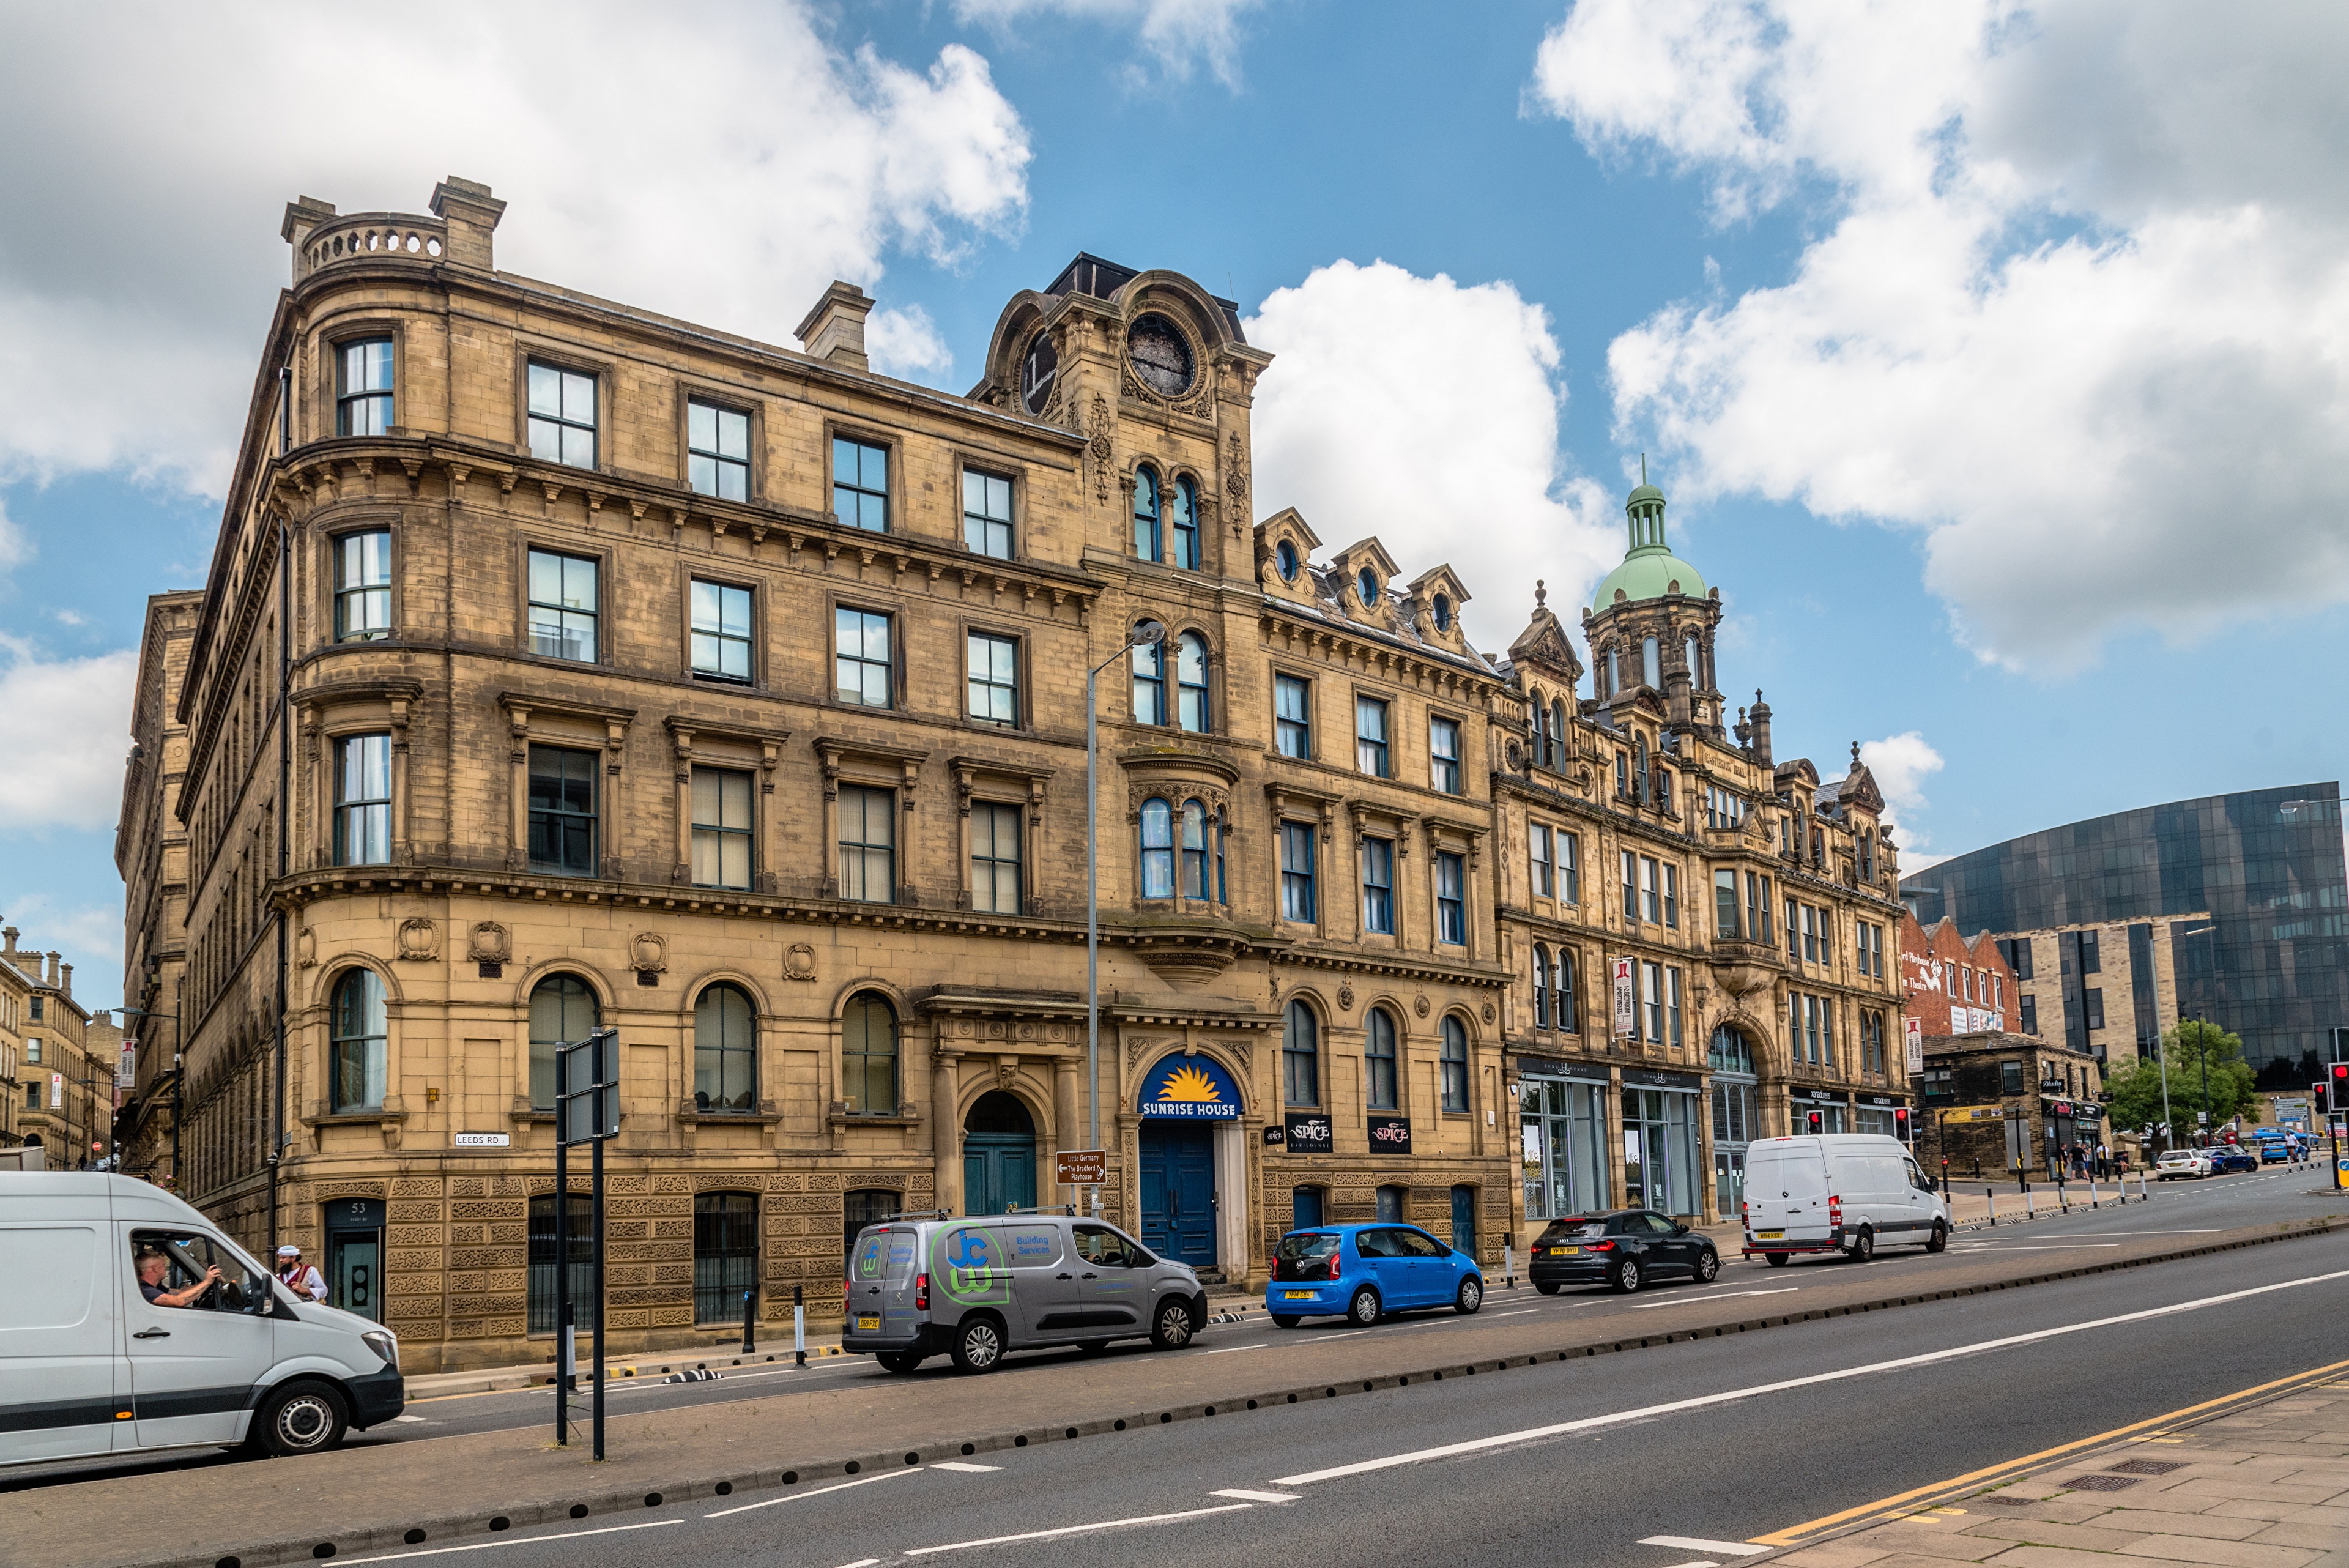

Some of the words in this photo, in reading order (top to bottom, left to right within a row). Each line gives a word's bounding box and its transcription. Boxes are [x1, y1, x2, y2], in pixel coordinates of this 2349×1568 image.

[1909, 951, 1929, 967] Playhouse
[1909, 977, 1927, 991] Theatre
[1143, 1103, 1193, 1115] SUNRISE
[1197, 1104, 1235, 1116] HOUSE
[1267, 1131, 1282, 1140] SPICE
[1290, 1122, 1330, 1141] SPICE
[1372, 1124, 1408, 1143] SPICE
[352, 1202, 366, 1214] 53
[1016, 1236, 1049, 1245] Building
[1019, 1246, 1050, 1255] Services
[869, 1318, 878, 1328] FXC
